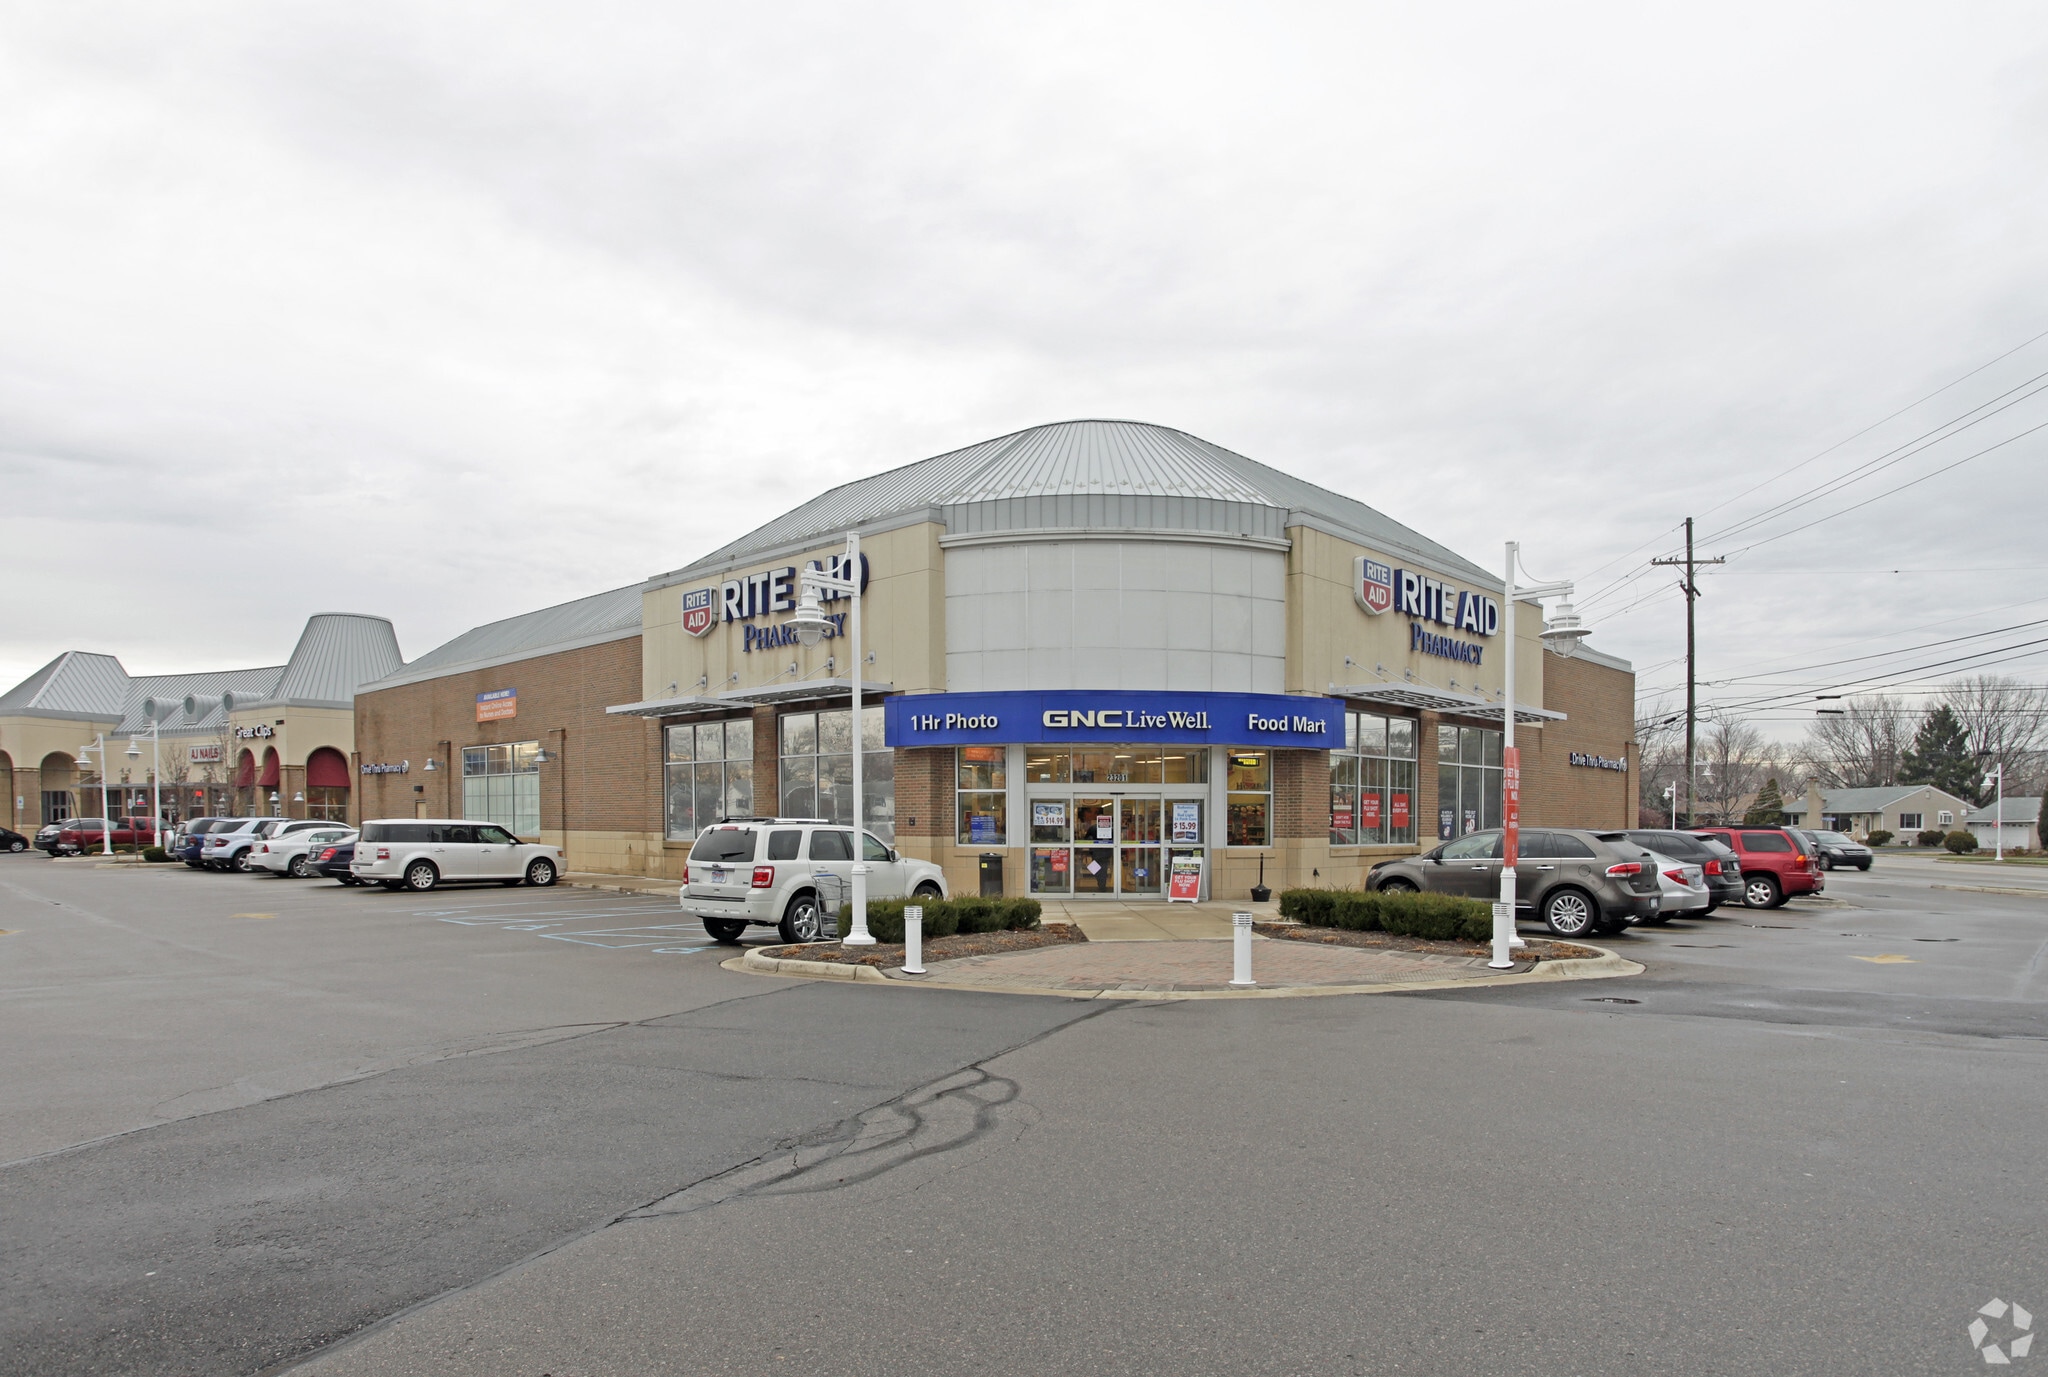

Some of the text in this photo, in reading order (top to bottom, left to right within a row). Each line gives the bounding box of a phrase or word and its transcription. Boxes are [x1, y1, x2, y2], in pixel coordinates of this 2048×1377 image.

[1367, 562, 1388, 583] RITE
[686, 589, 708, 608] RITE
[720, 567, 795, 622] RITE
[1368, 585, 1387, 605] AID
[1399, 568, 1500, 637] RITE AID
[687, 609, 707, 629] AID
[1411, 622, 1485, 666] PHARMACY
[910, 712, 999, 731] 1 Hr Photo
[1042, 709, 1212, 729] GNC Live Well.
[1248, 713, 1327, 734] Food Mart
[234, 723, 272, 739] Great Clips
[191, 747, 220, 760] AJ NAILS
[1571, 752, 1621, 772] Drive Thru Pharmacy
[381, 763, 401, 774] Pharmacy
[1107, 774, 1127, 782] 23201
